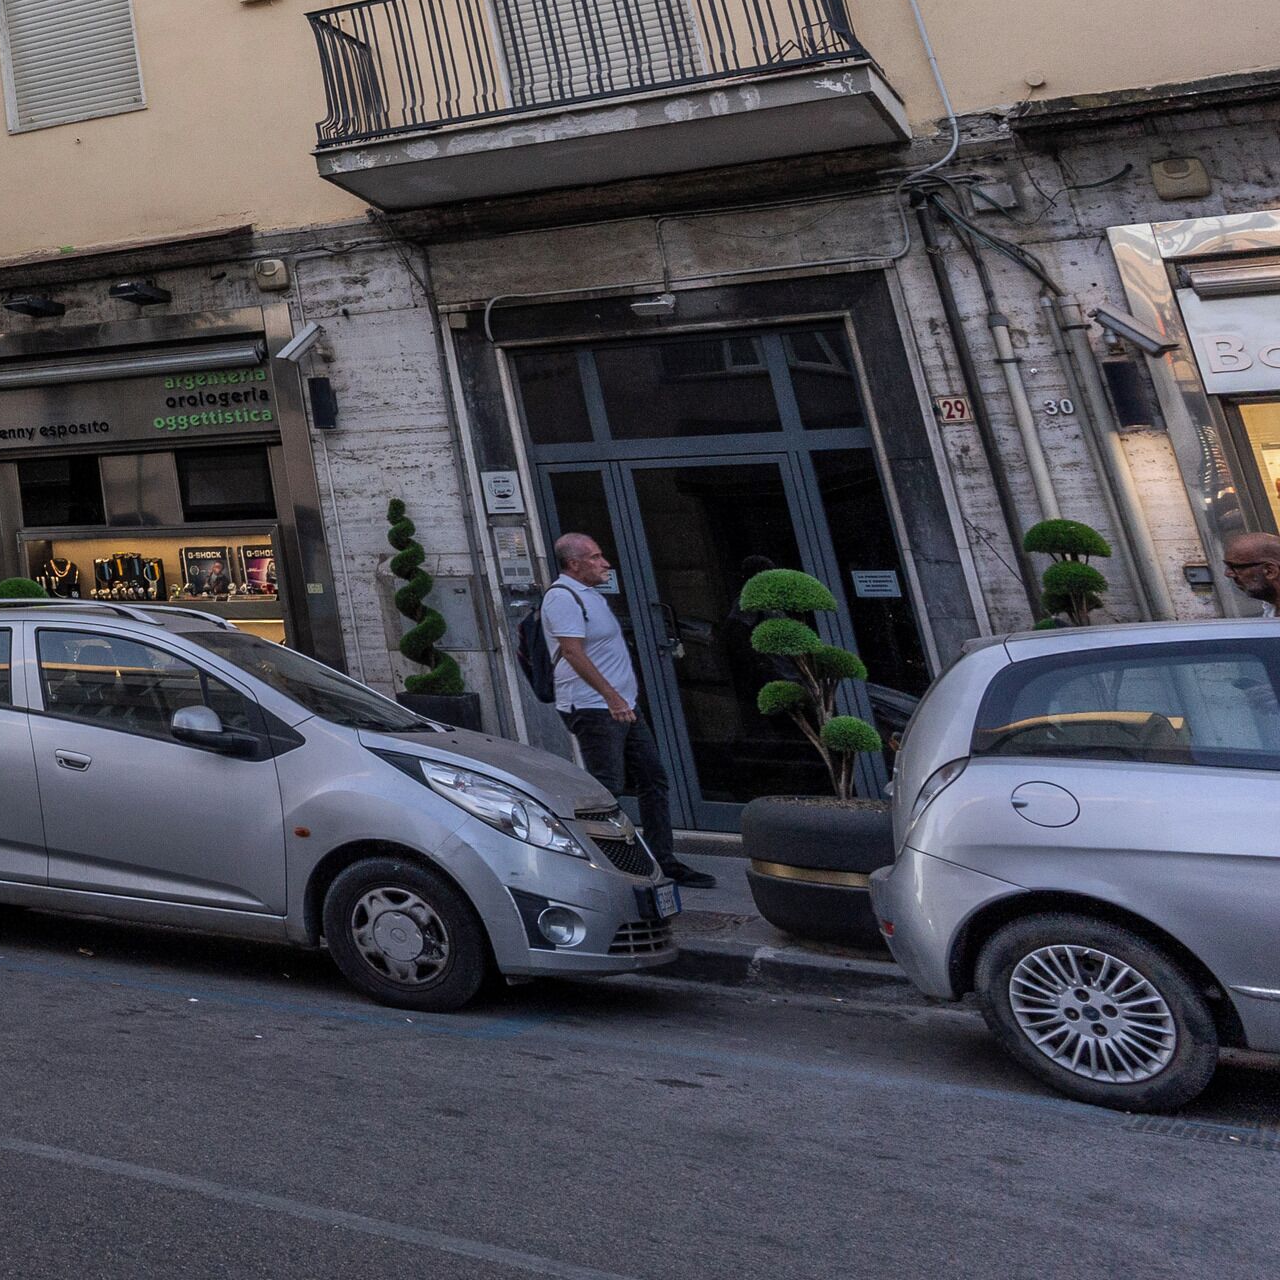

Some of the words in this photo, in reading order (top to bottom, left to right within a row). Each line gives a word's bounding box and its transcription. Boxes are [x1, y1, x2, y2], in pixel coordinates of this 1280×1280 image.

[164, 369, 266, 391] argenteria
[166, 387, 270, 409] orologeria
[1043, 398, 1074, 415] 30
[942, 400, 965, 419] 29
[39, 420, 110, 438] esposito
[153, 408, 273, 431] oggettistica
[188, 551, 222, 559] G-SHOCK
